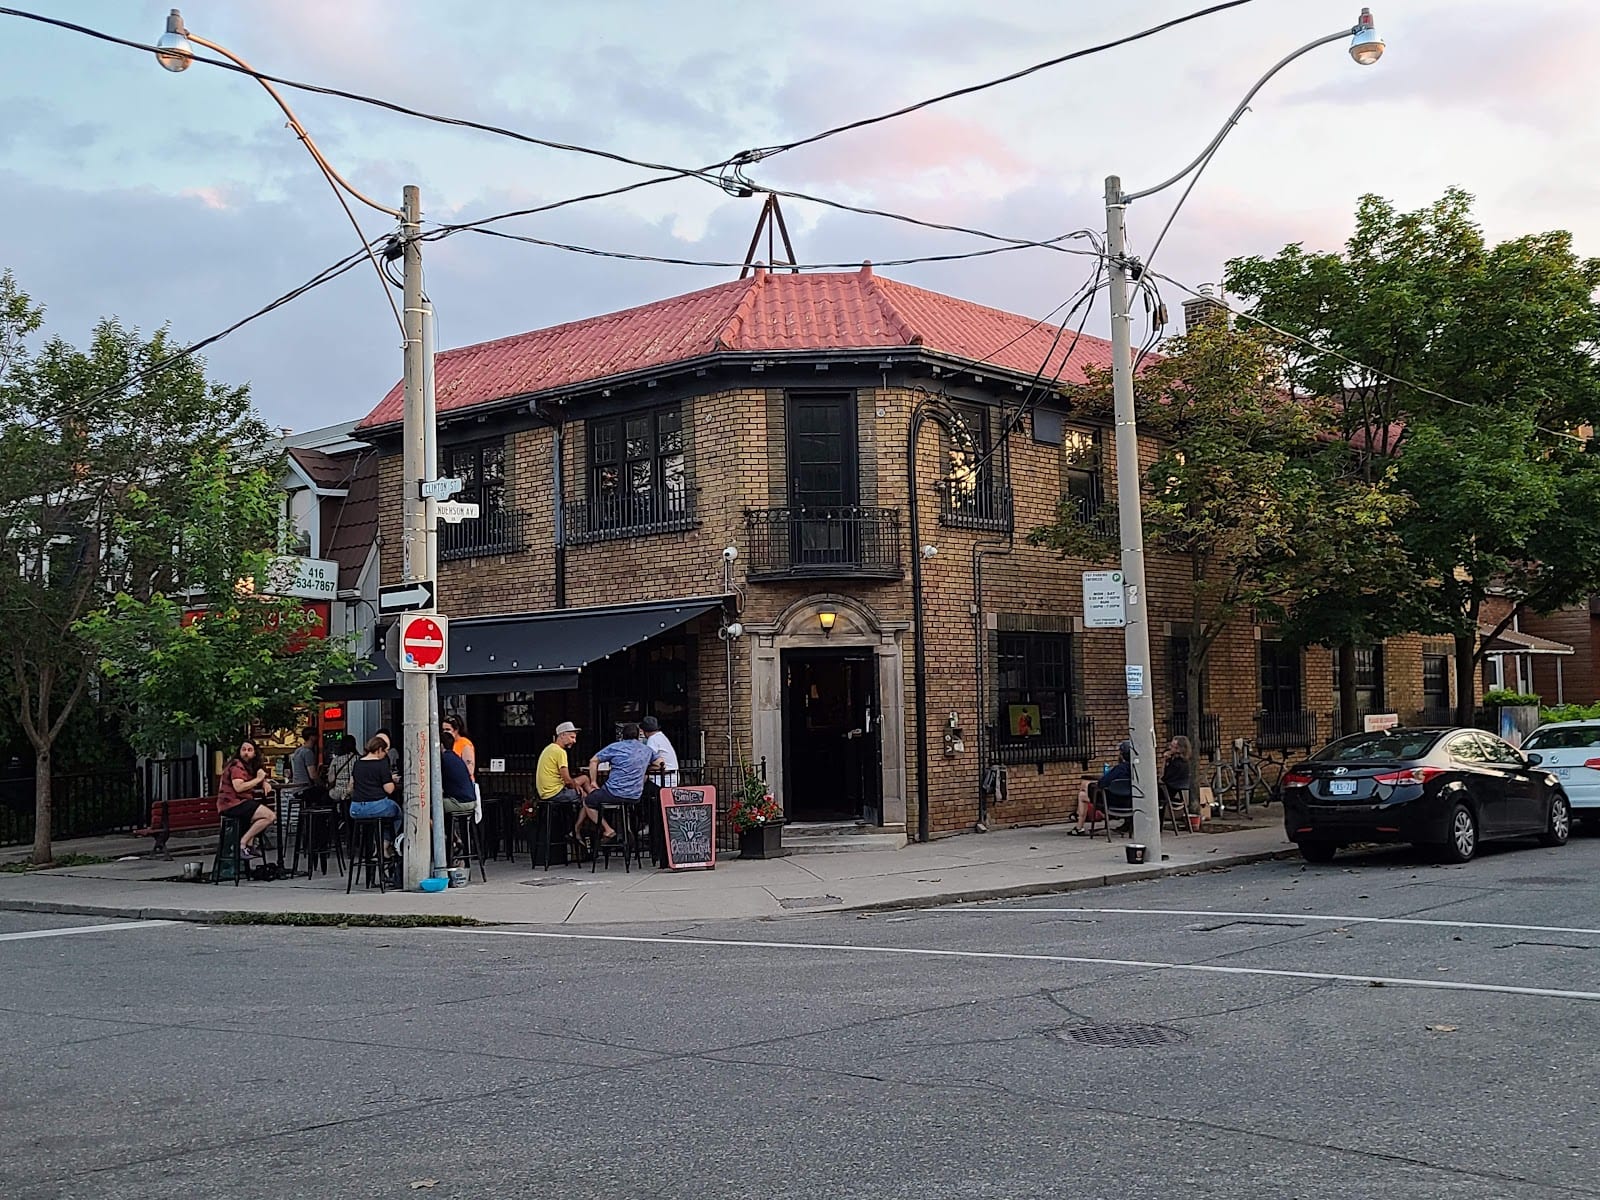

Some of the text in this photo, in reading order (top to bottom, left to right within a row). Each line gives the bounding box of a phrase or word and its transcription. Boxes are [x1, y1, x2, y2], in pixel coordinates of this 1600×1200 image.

[425, 482, 447, 494] CLINTON
[450, 480, 457, 490] ST
[435, 505, 465, 516] NDERSON
[308, 567, 324, 579] 416
[296, 577, 335, 592] 534-7867
